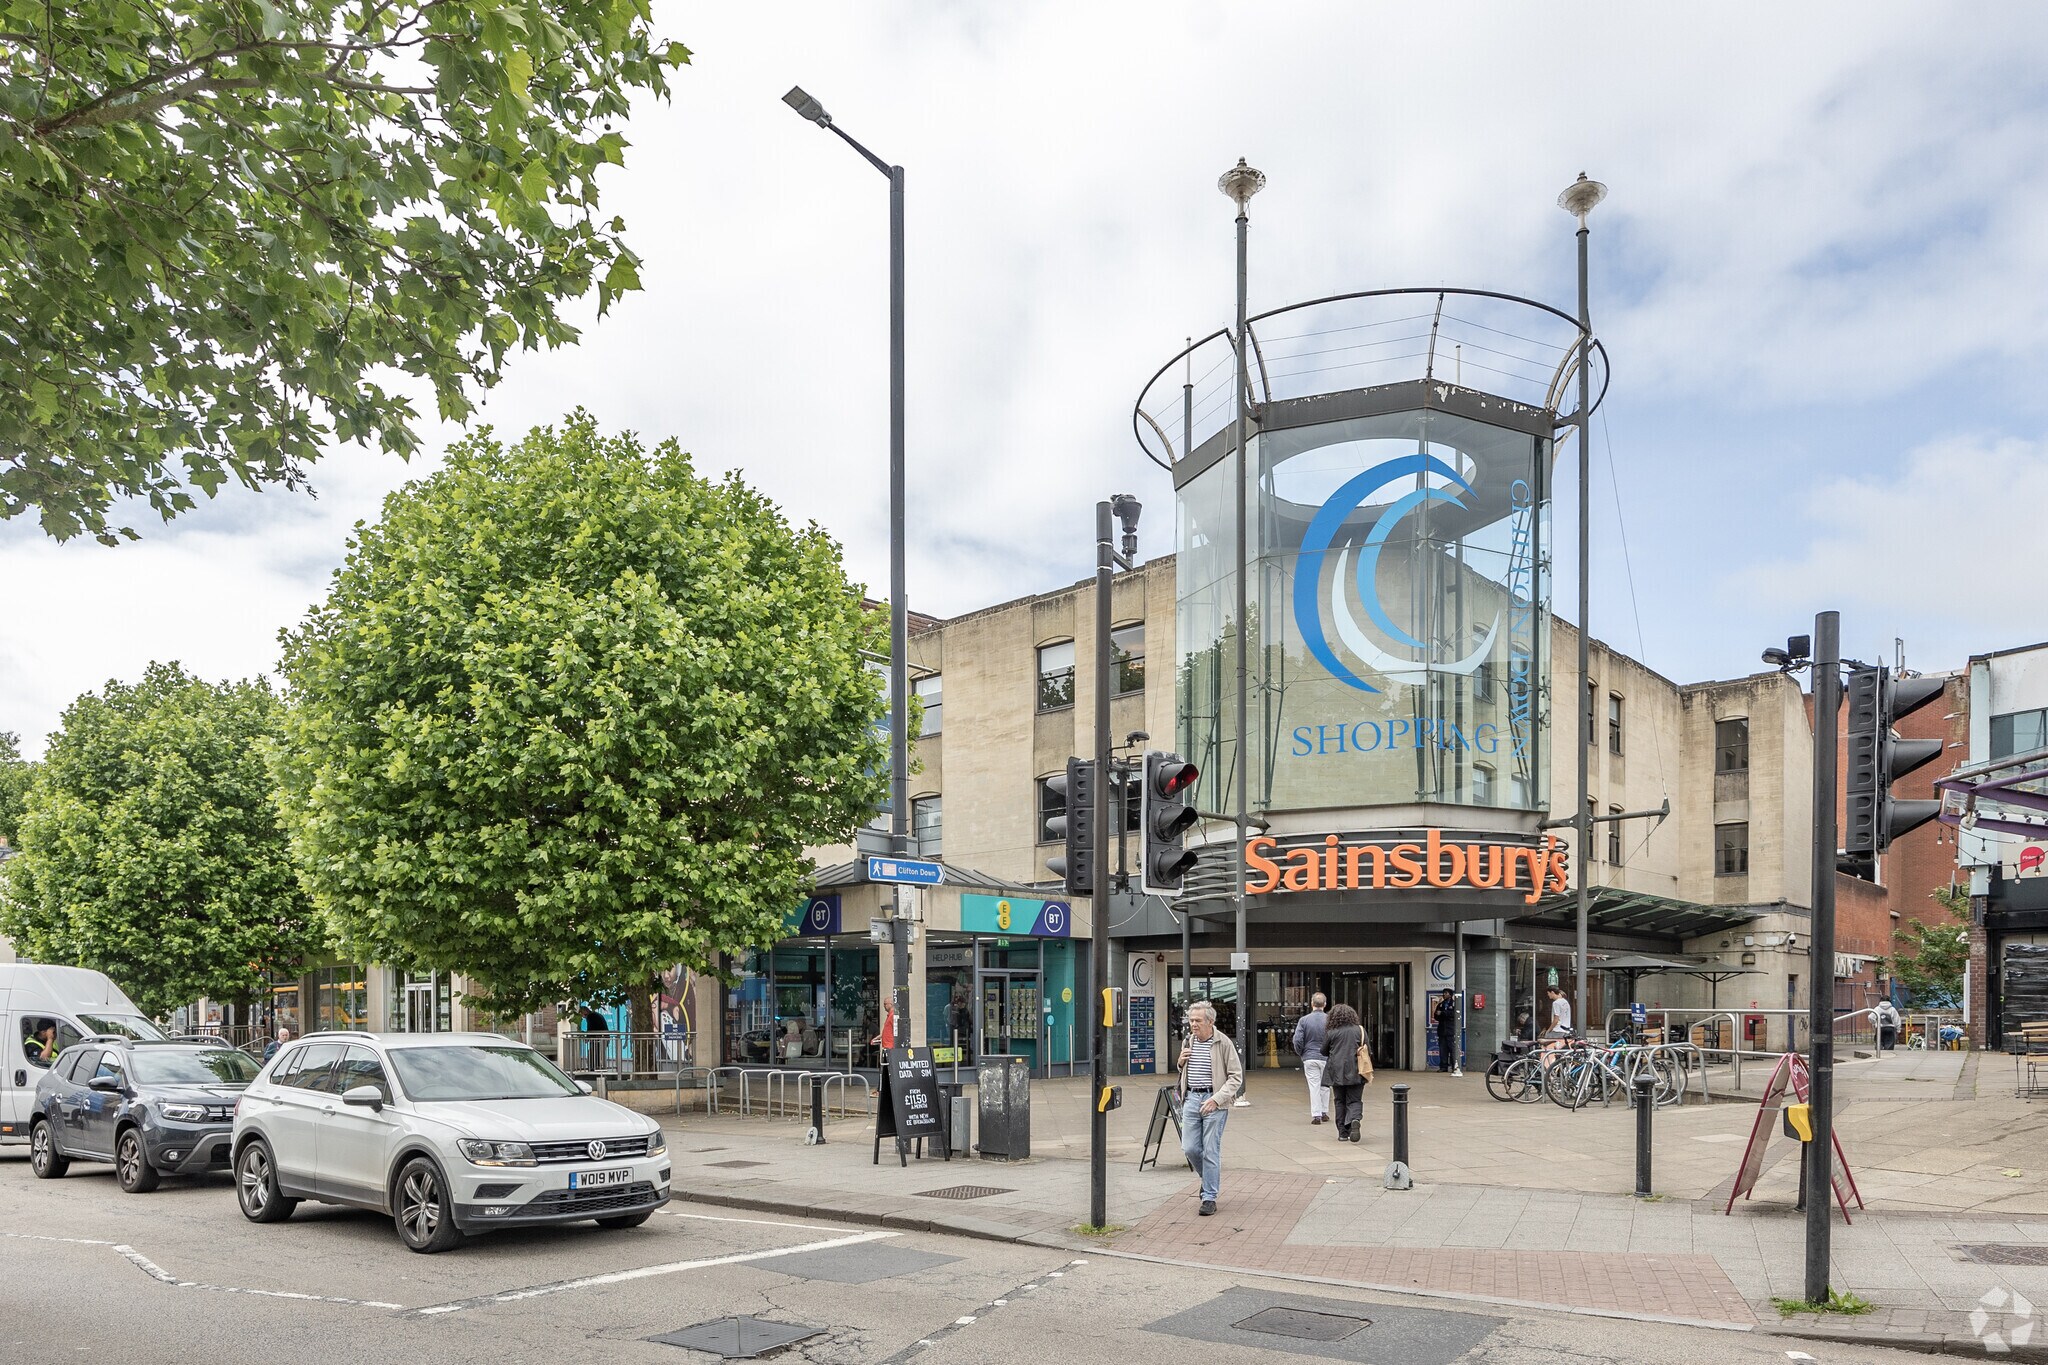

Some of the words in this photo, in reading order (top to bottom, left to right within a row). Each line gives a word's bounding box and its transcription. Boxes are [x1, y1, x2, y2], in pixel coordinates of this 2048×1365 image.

[1511, 479, 1530, 637] CLIFTON
[1511, 651, 1530, 760] DOWN
[1292, 717, 1499, 757] SHOPPING
[898, 866, 918, 876] Clifton
[920, 868, 936, 877] Down
[1245, 829, 1566, 905] Sainsbury's
[815, 910, 826, 921] BT
[1048, 913, 1059, 924] BT
[899, 1060, 929, 1069] UNLIMITED
[899, 1070, 913, 1078] DATA
[921, 1069, 932, 1077] SIM
[581, 1172, 605, 1186] WO19
[608, 1170, 629, 1183] MVP
